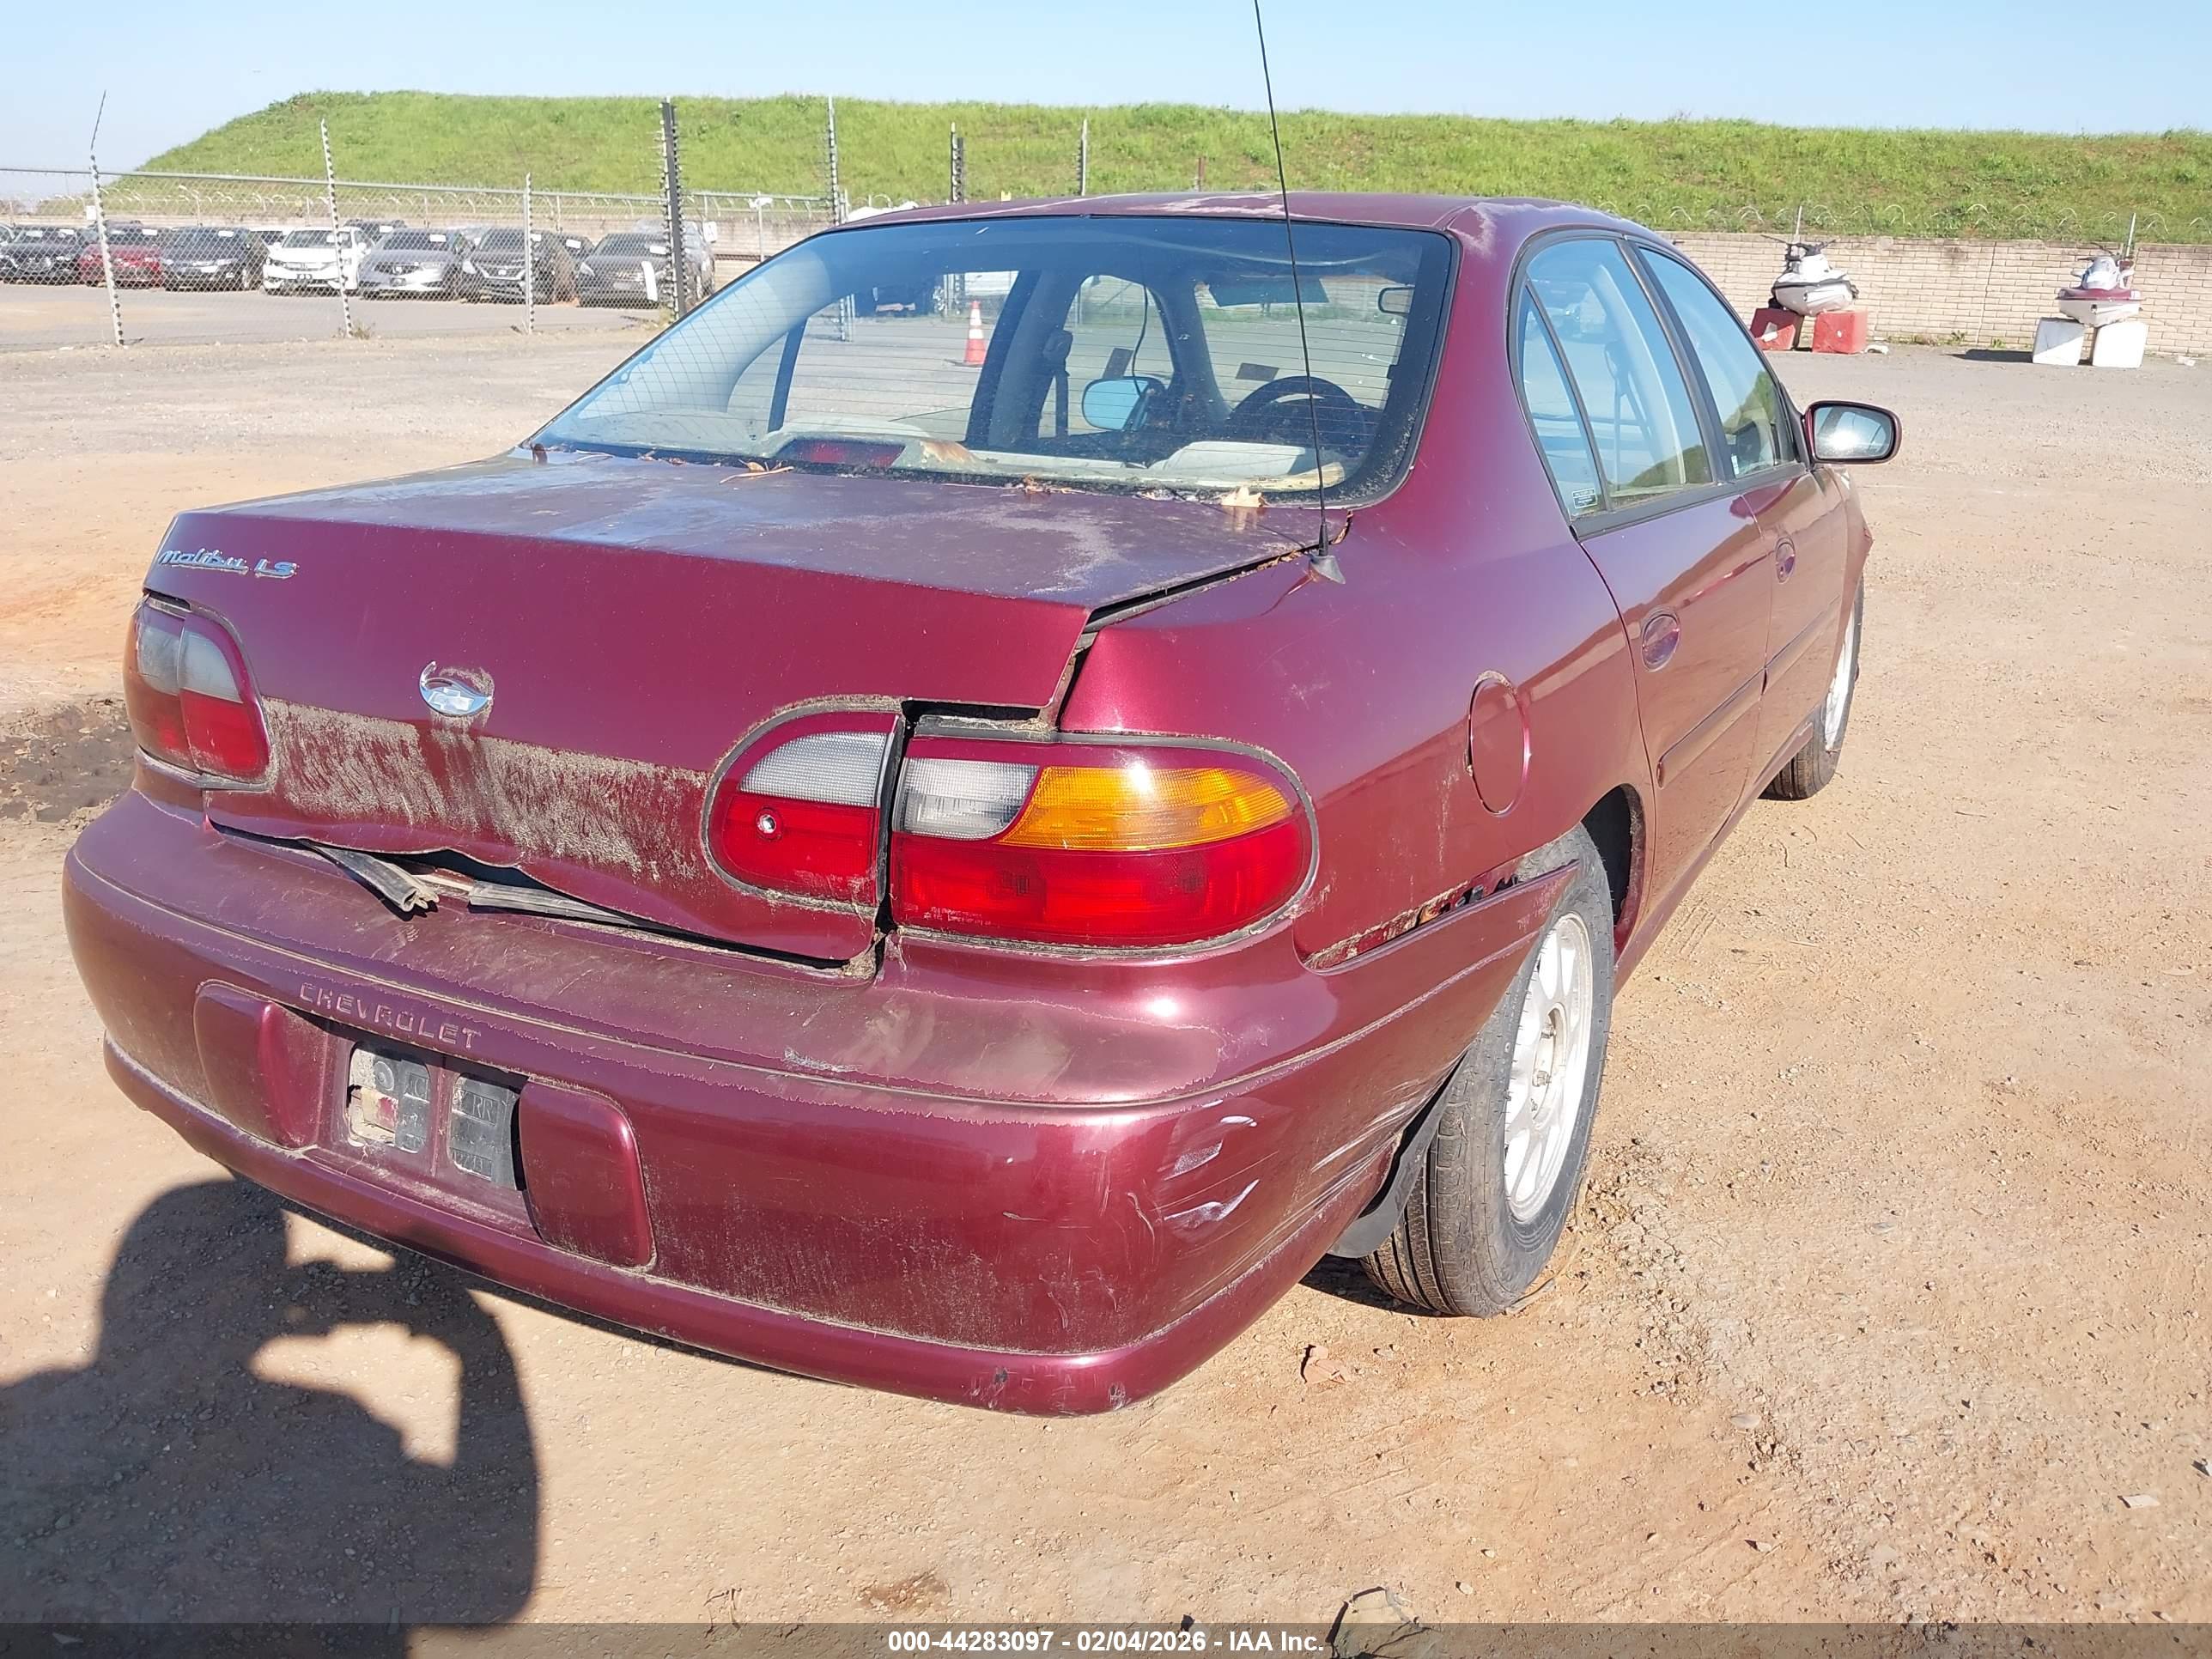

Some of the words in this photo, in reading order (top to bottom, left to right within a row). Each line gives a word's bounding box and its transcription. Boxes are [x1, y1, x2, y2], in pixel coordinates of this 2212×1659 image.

[158, 547, 249, 574] Malibu
[254, 558, 300, 579] LS
[300, 981, 482, 1049] CHEVROLET
